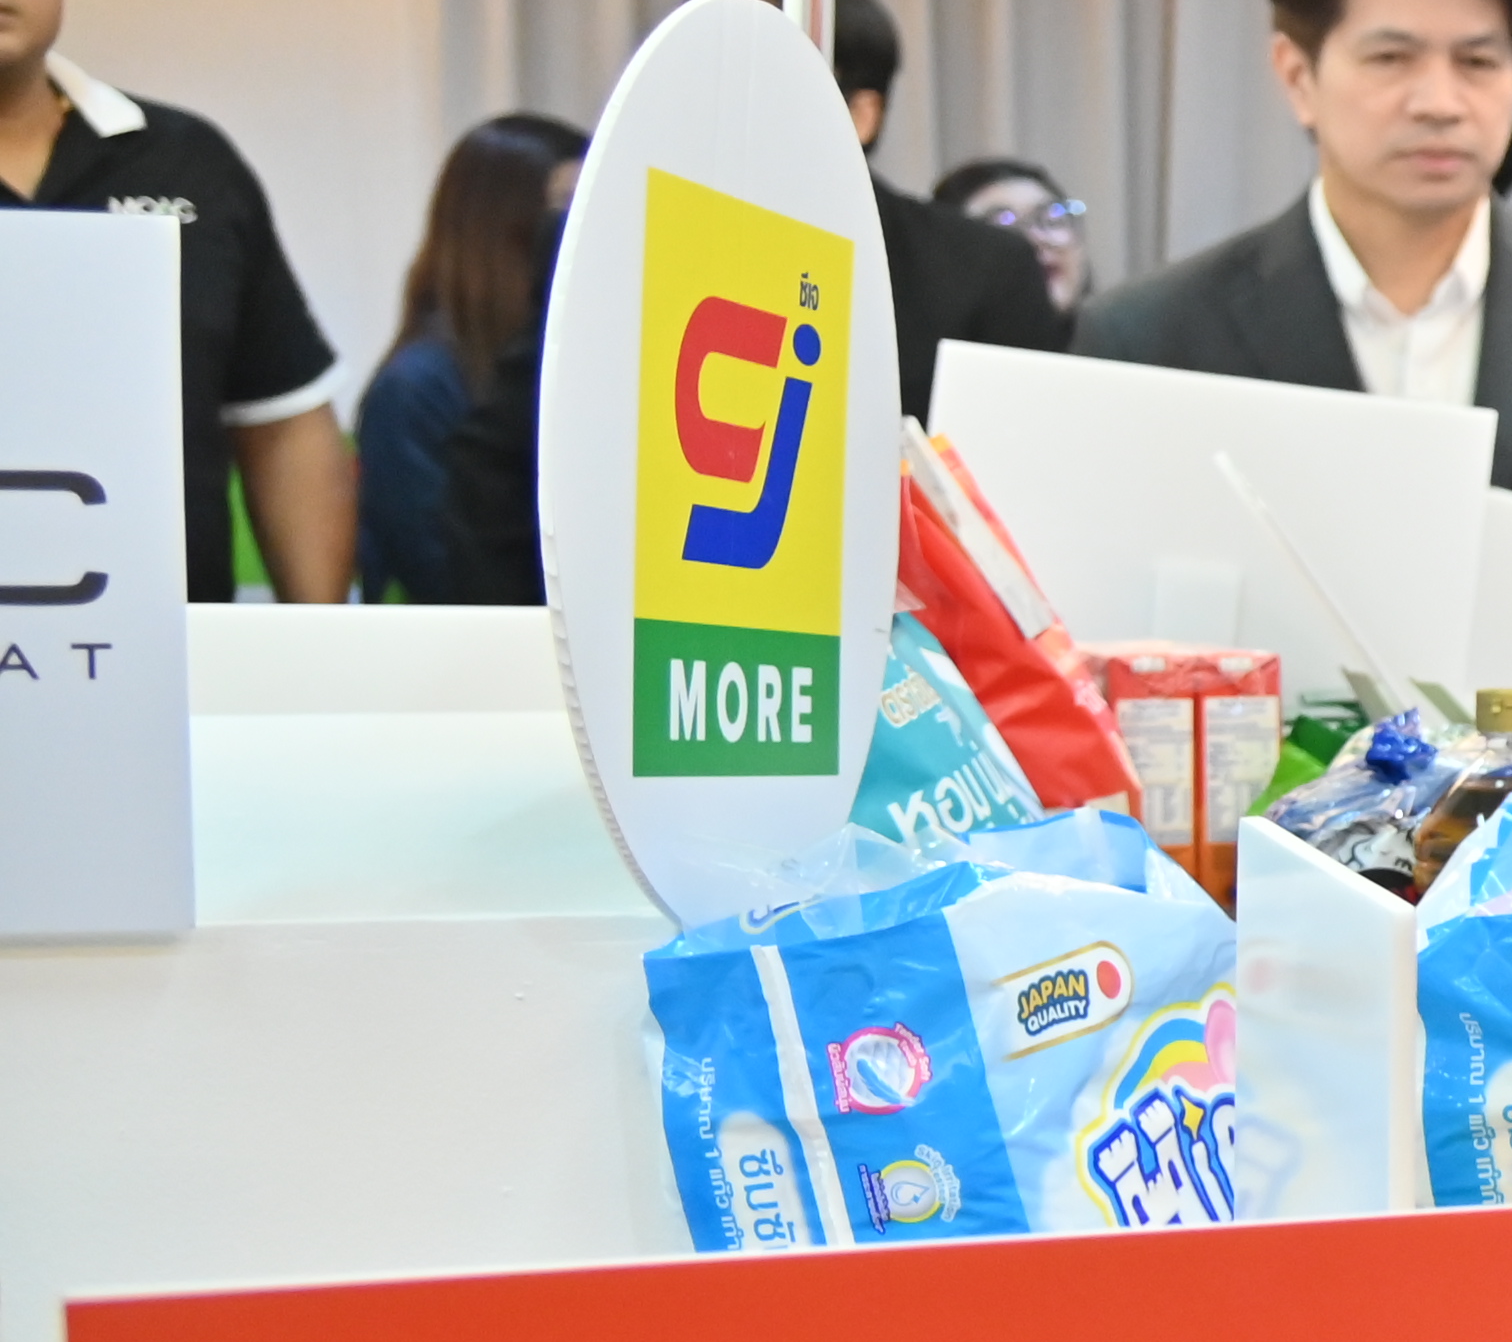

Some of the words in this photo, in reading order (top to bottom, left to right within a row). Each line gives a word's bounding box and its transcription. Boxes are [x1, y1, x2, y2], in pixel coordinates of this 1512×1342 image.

[668, 657, 815, 746] MORE
[1019, 972, 1087, 1020] JAPAN
[1027, 999, 1088, 1032] QUALITY
[1468, 1093, 1483, 1104] 1
[705, 1146, 720, 1158] 1
